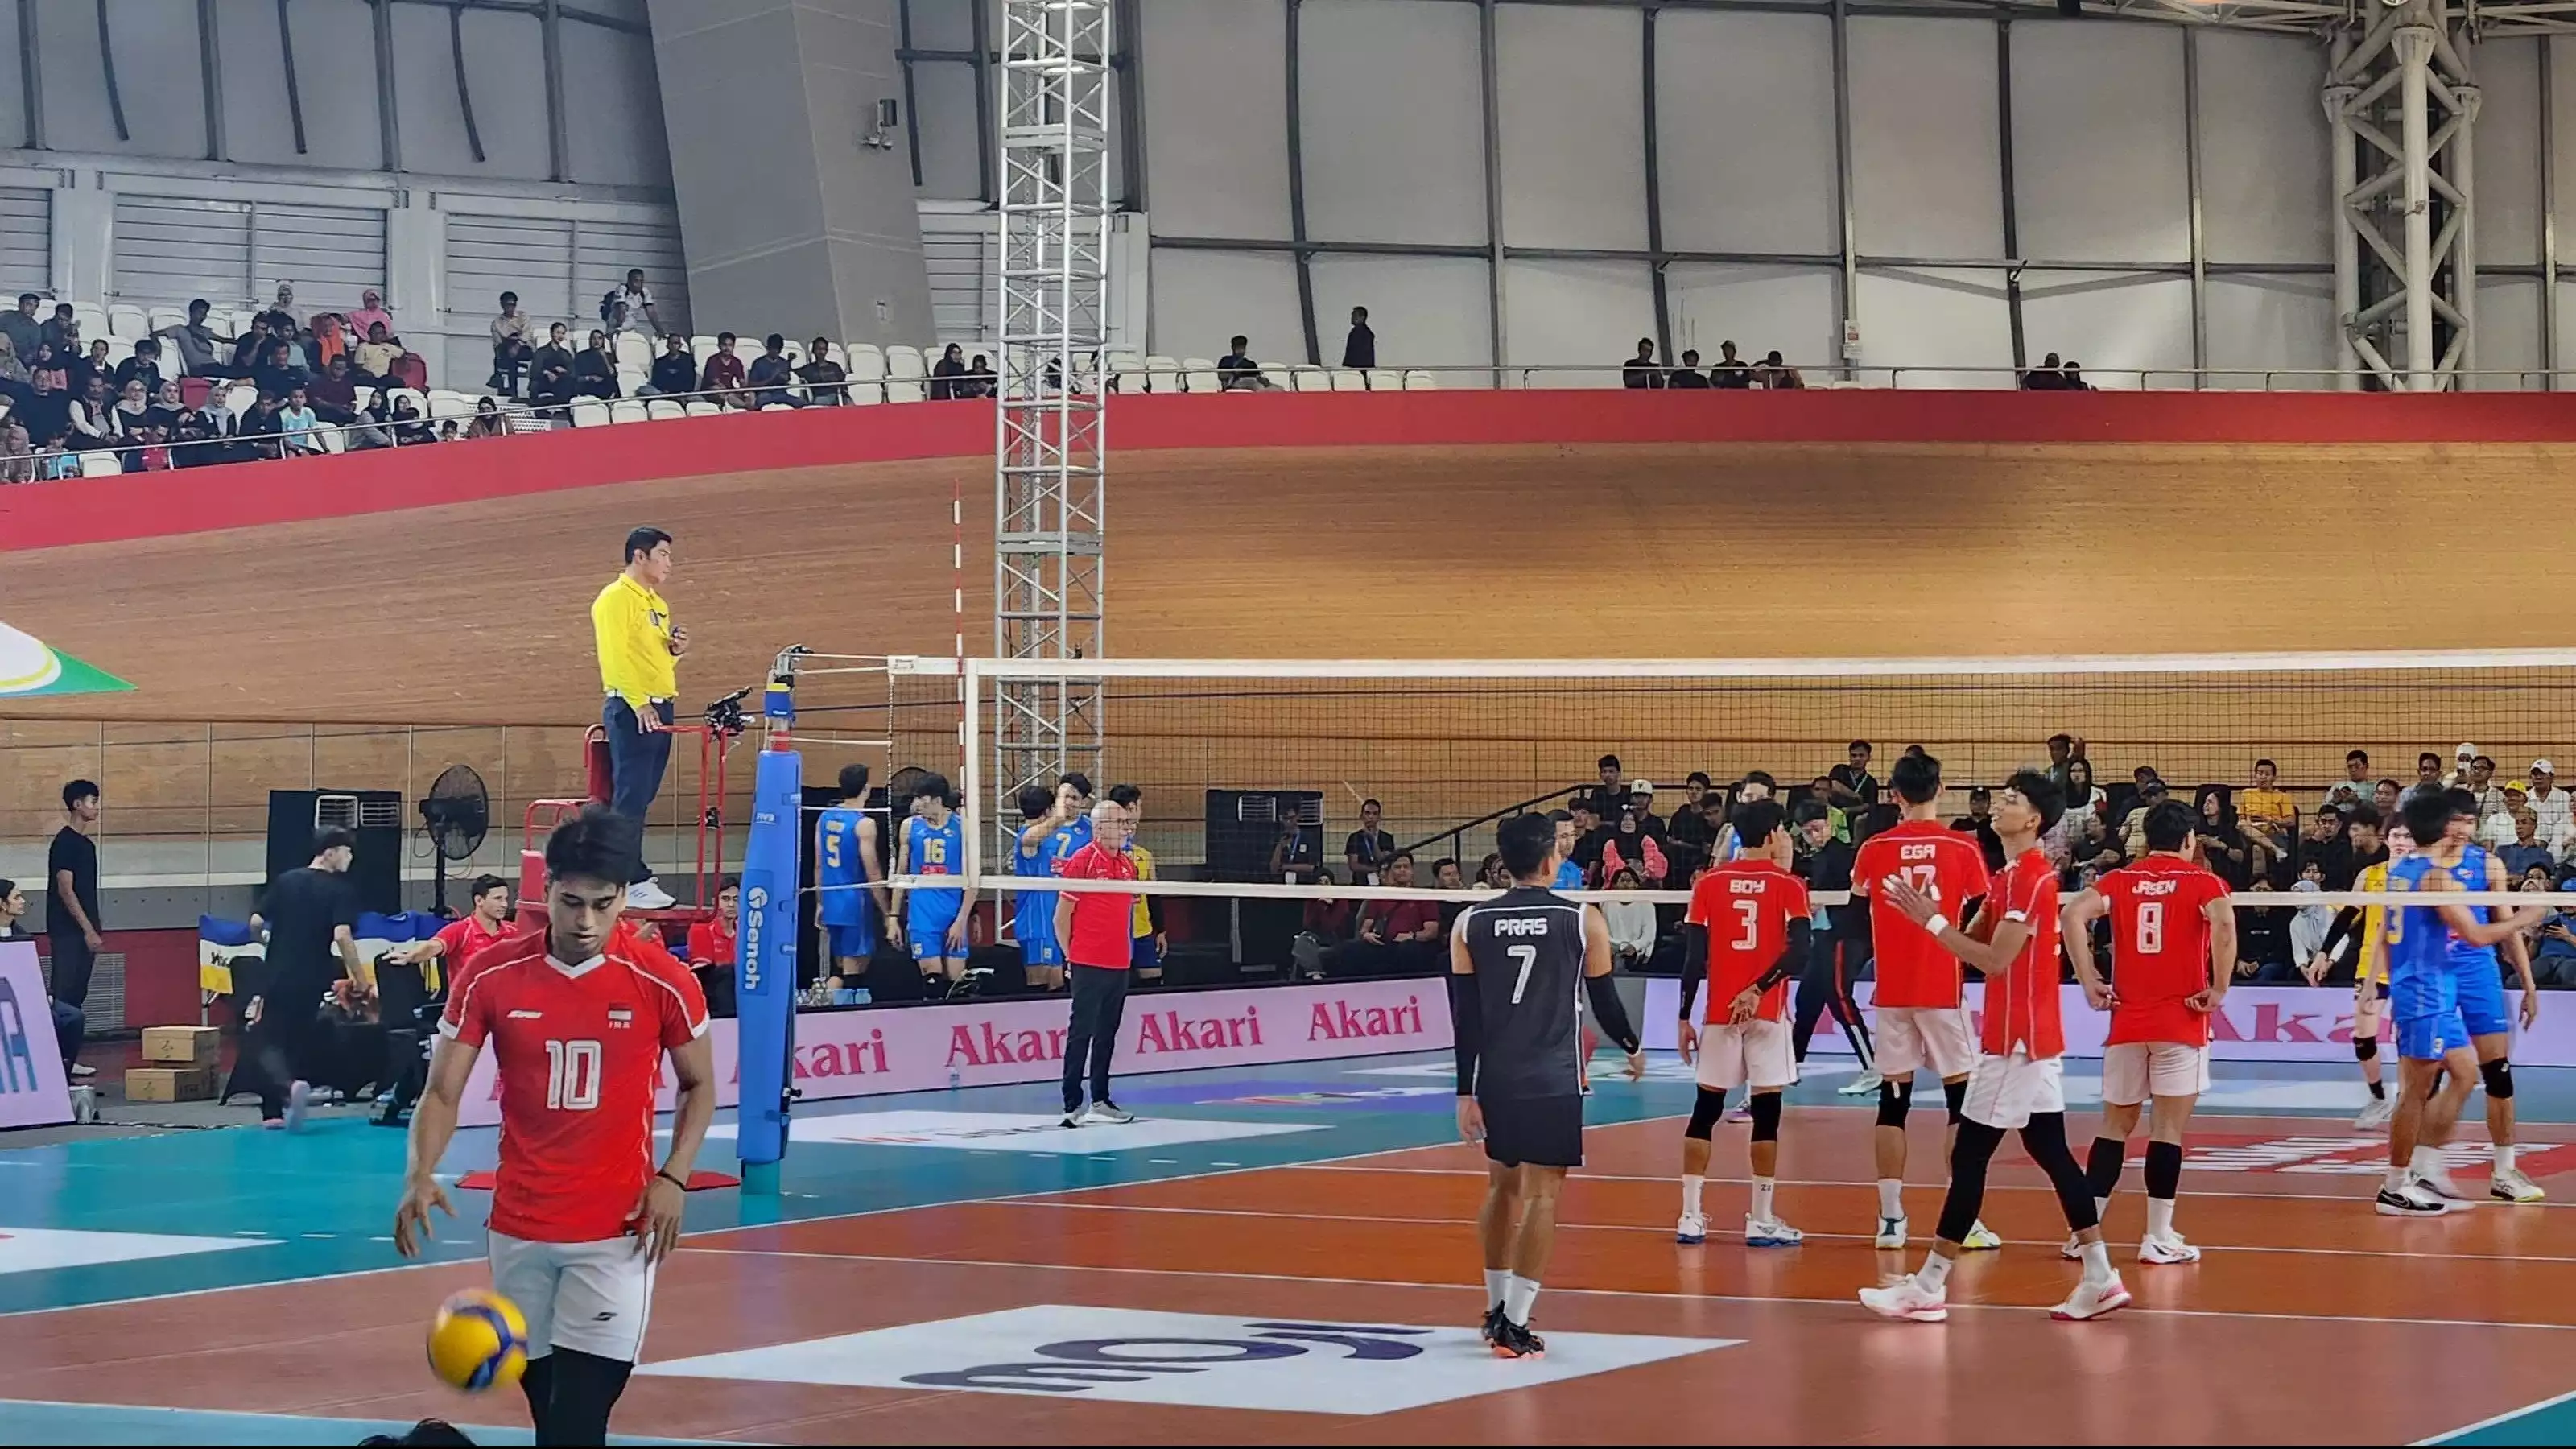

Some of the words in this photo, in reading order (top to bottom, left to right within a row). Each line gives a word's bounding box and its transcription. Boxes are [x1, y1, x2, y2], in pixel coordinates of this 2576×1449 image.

[827, 835, 841, 868] 5
[923, 838, 947, 864] 16
[1056, 833, 1071, 857] 7
[1729, 879, 1765, 894] BOY
[1494, 917, 1548, 937] PRAS
[1732, 899, 1758, 951] 3
[2136, 902, 2163, 954] 8
[744, 910, 764, 991] Senoh
[1506, 944, 1537, 1005] 7
[1135, 1005, 1265, 1054] Akari
[1307, 995, 1423, 1042] Akari
[944, 1022, 1067, 1068] Akar
[545, 1039, 602, 1111] 10
